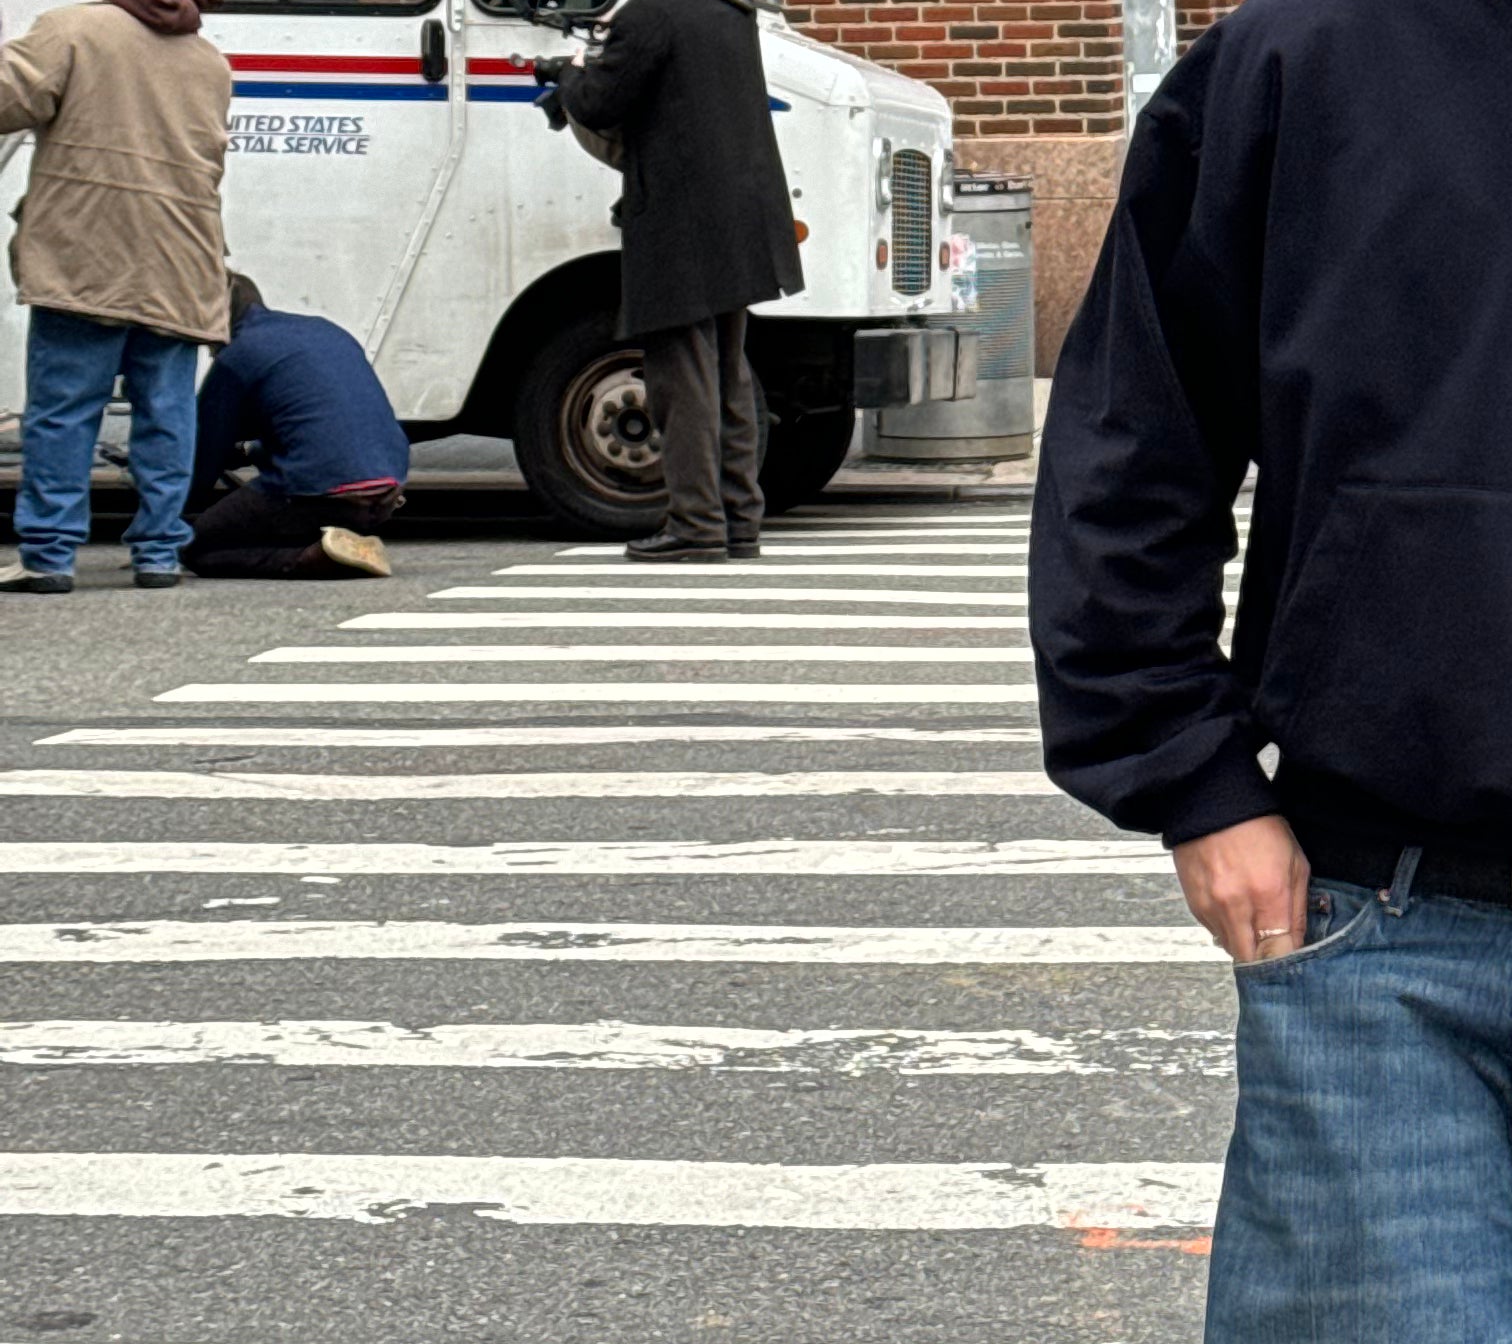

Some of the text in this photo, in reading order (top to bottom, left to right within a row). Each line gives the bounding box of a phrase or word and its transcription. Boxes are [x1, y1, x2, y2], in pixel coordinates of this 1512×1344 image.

[225, 115, 363, 133] NITED STATES
[228, 136, 369, 154] STAL SERVICE
